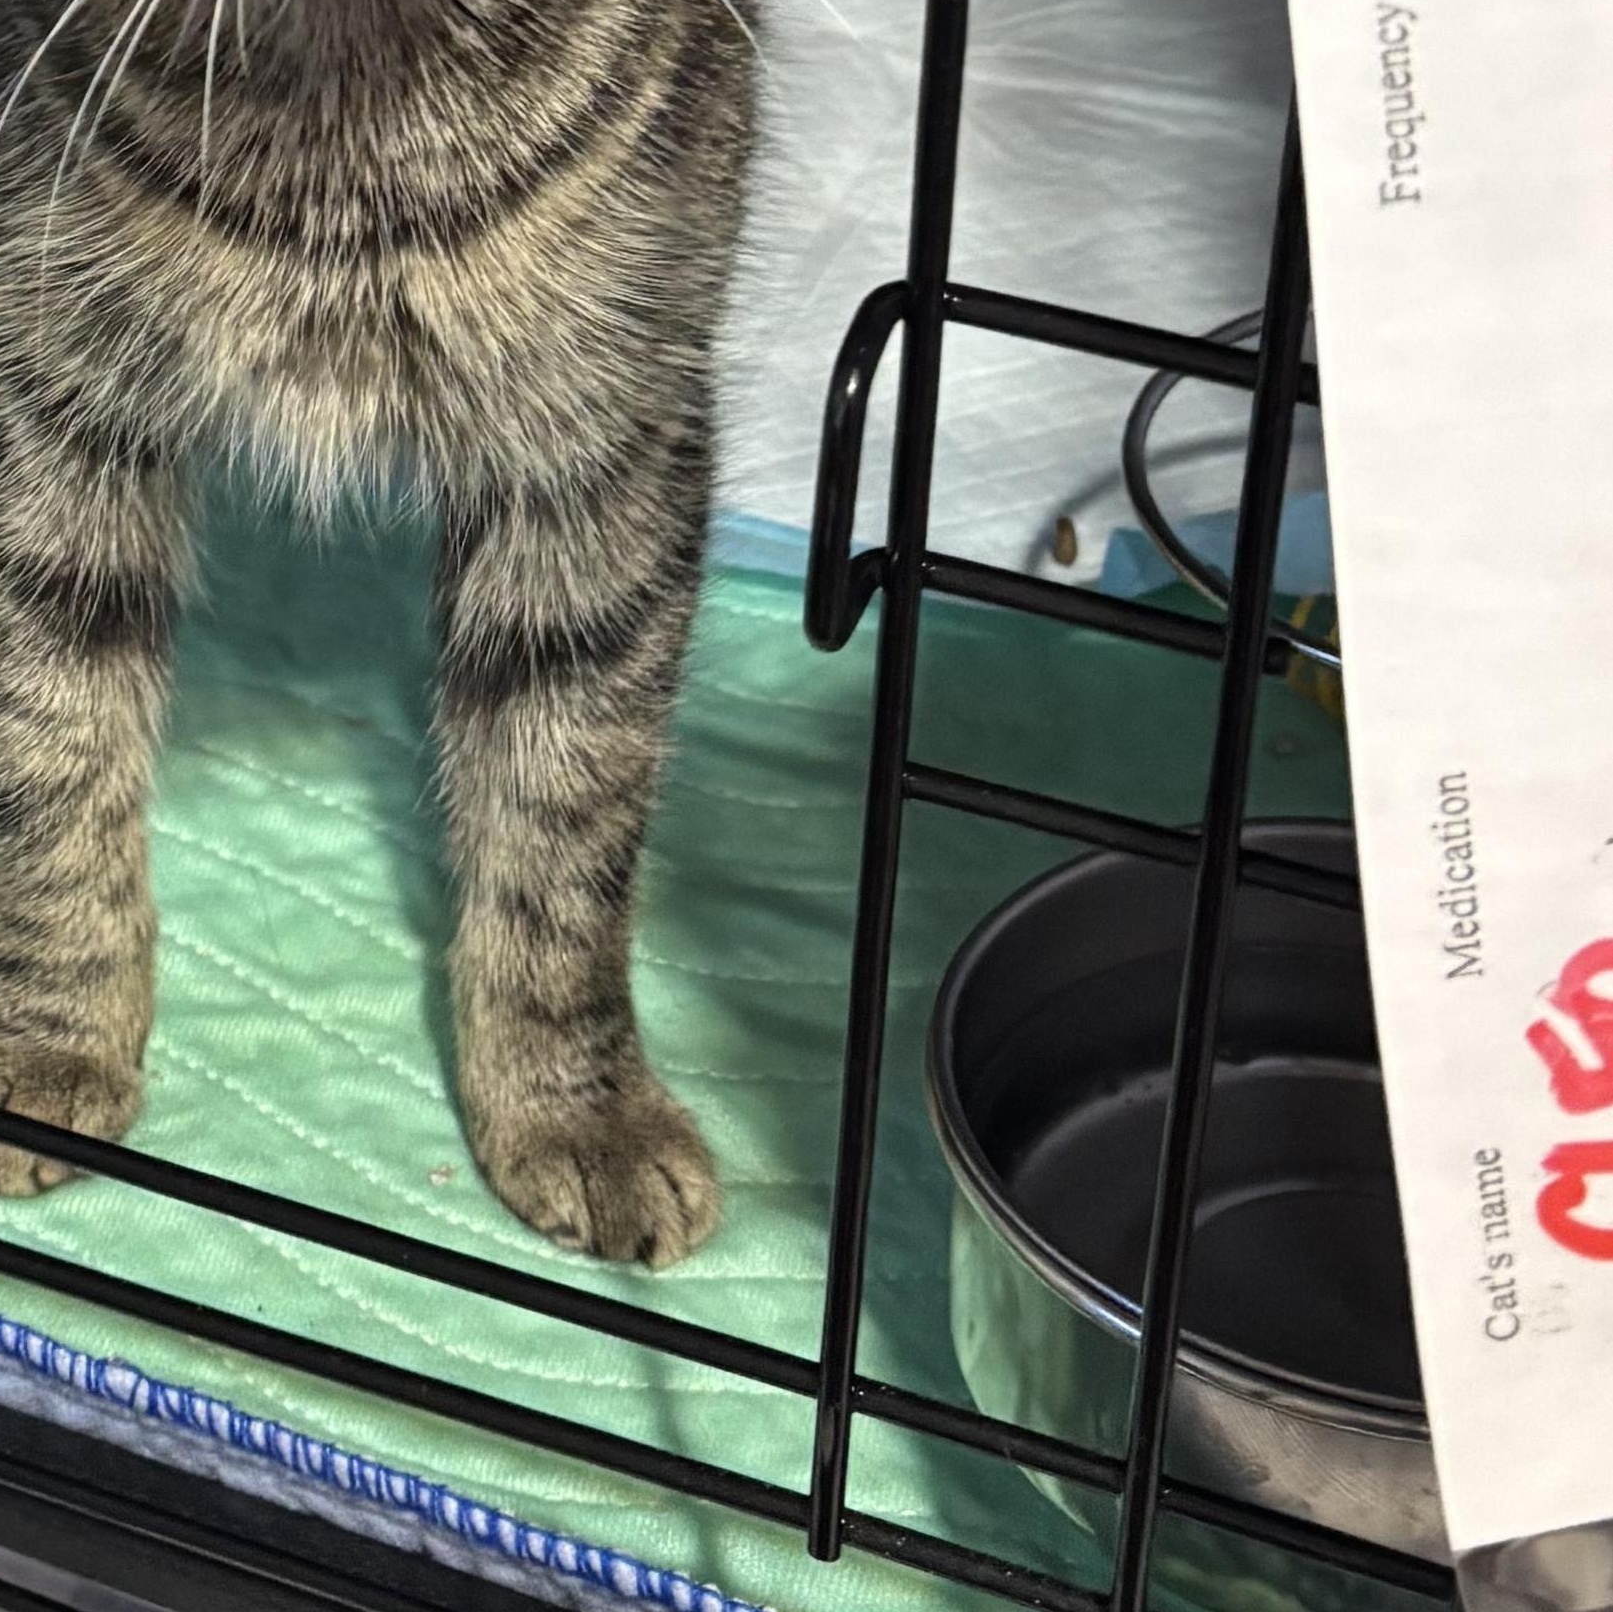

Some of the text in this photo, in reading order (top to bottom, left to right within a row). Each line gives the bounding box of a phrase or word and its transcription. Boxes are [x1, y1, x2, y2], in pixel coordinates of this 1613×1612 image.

[1370, 0, 1425, 207] Frequency
[1430, 770, 1485, 981] Medication
[1470, 1146, 1521, 1343] Cat's name
